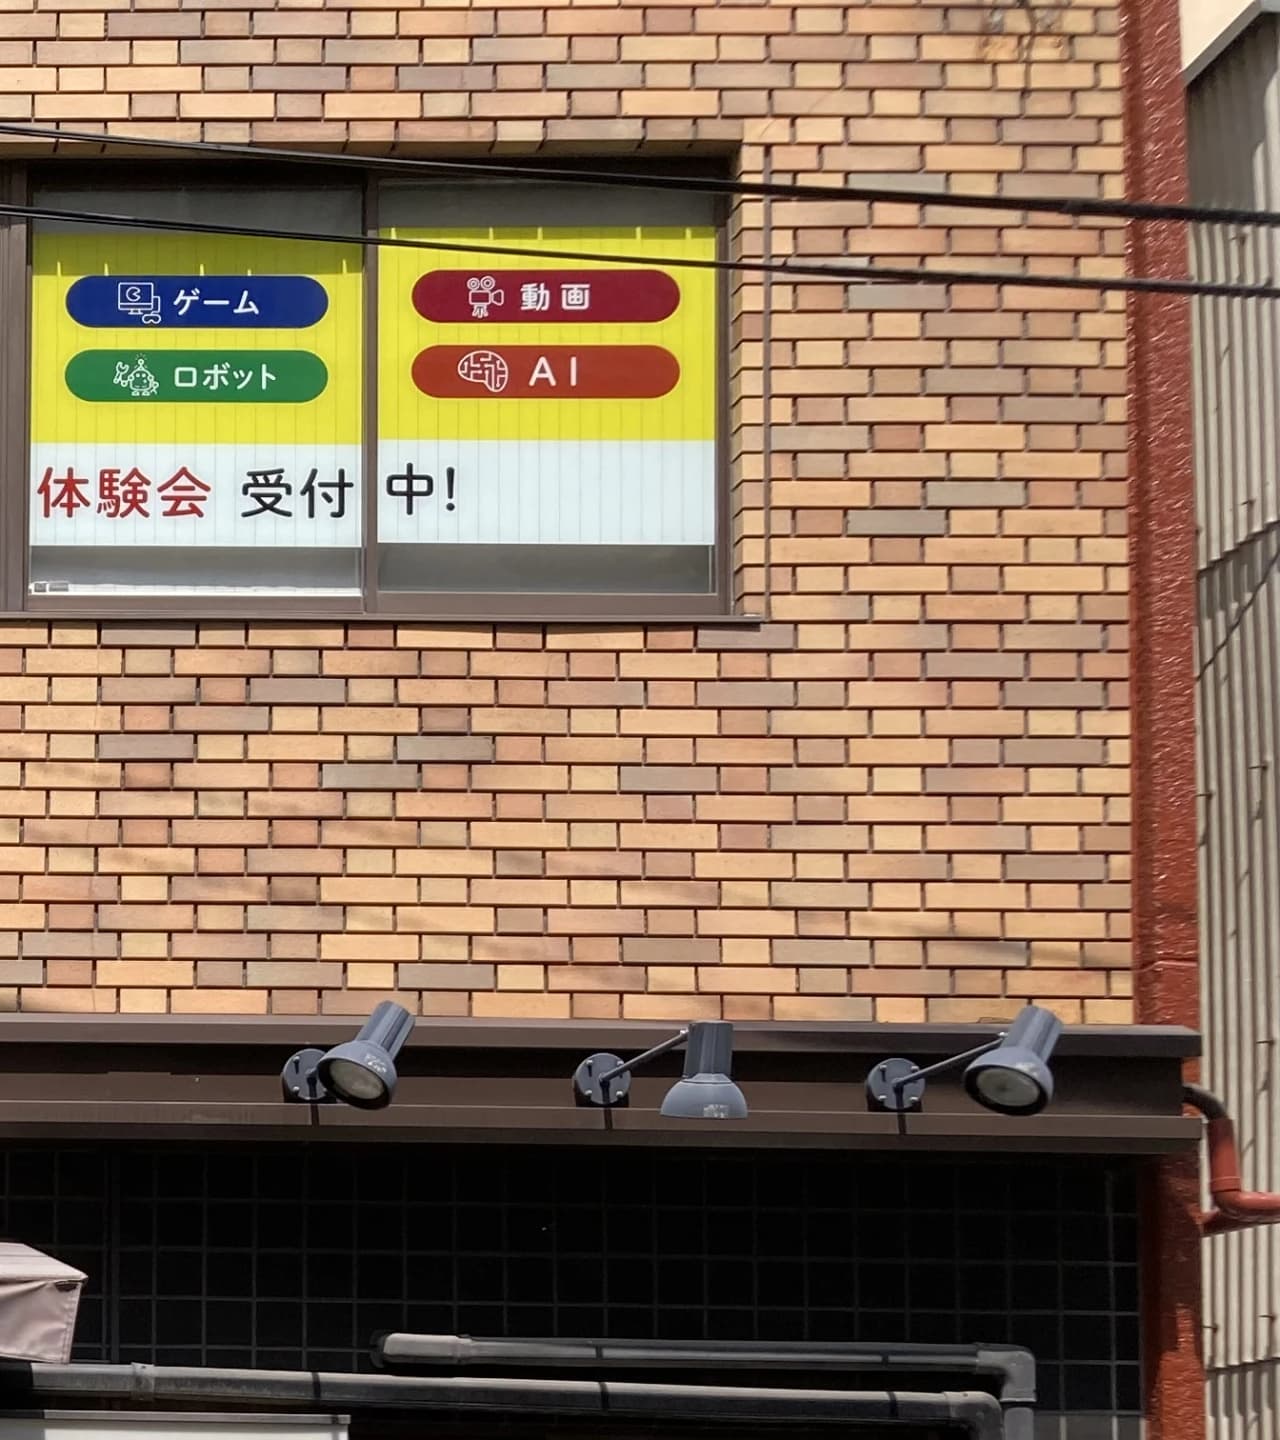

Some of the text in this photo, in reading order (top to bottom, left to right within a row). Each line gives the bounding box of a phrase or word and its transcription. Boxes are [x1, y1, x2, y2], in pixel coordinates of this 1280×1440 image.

[171, 289, 260, 317] ゲーム
[519, 281, 592, 312] 動画
[173, 363, 278, 390] ロボット
[528, 356, 579, 388] AI
